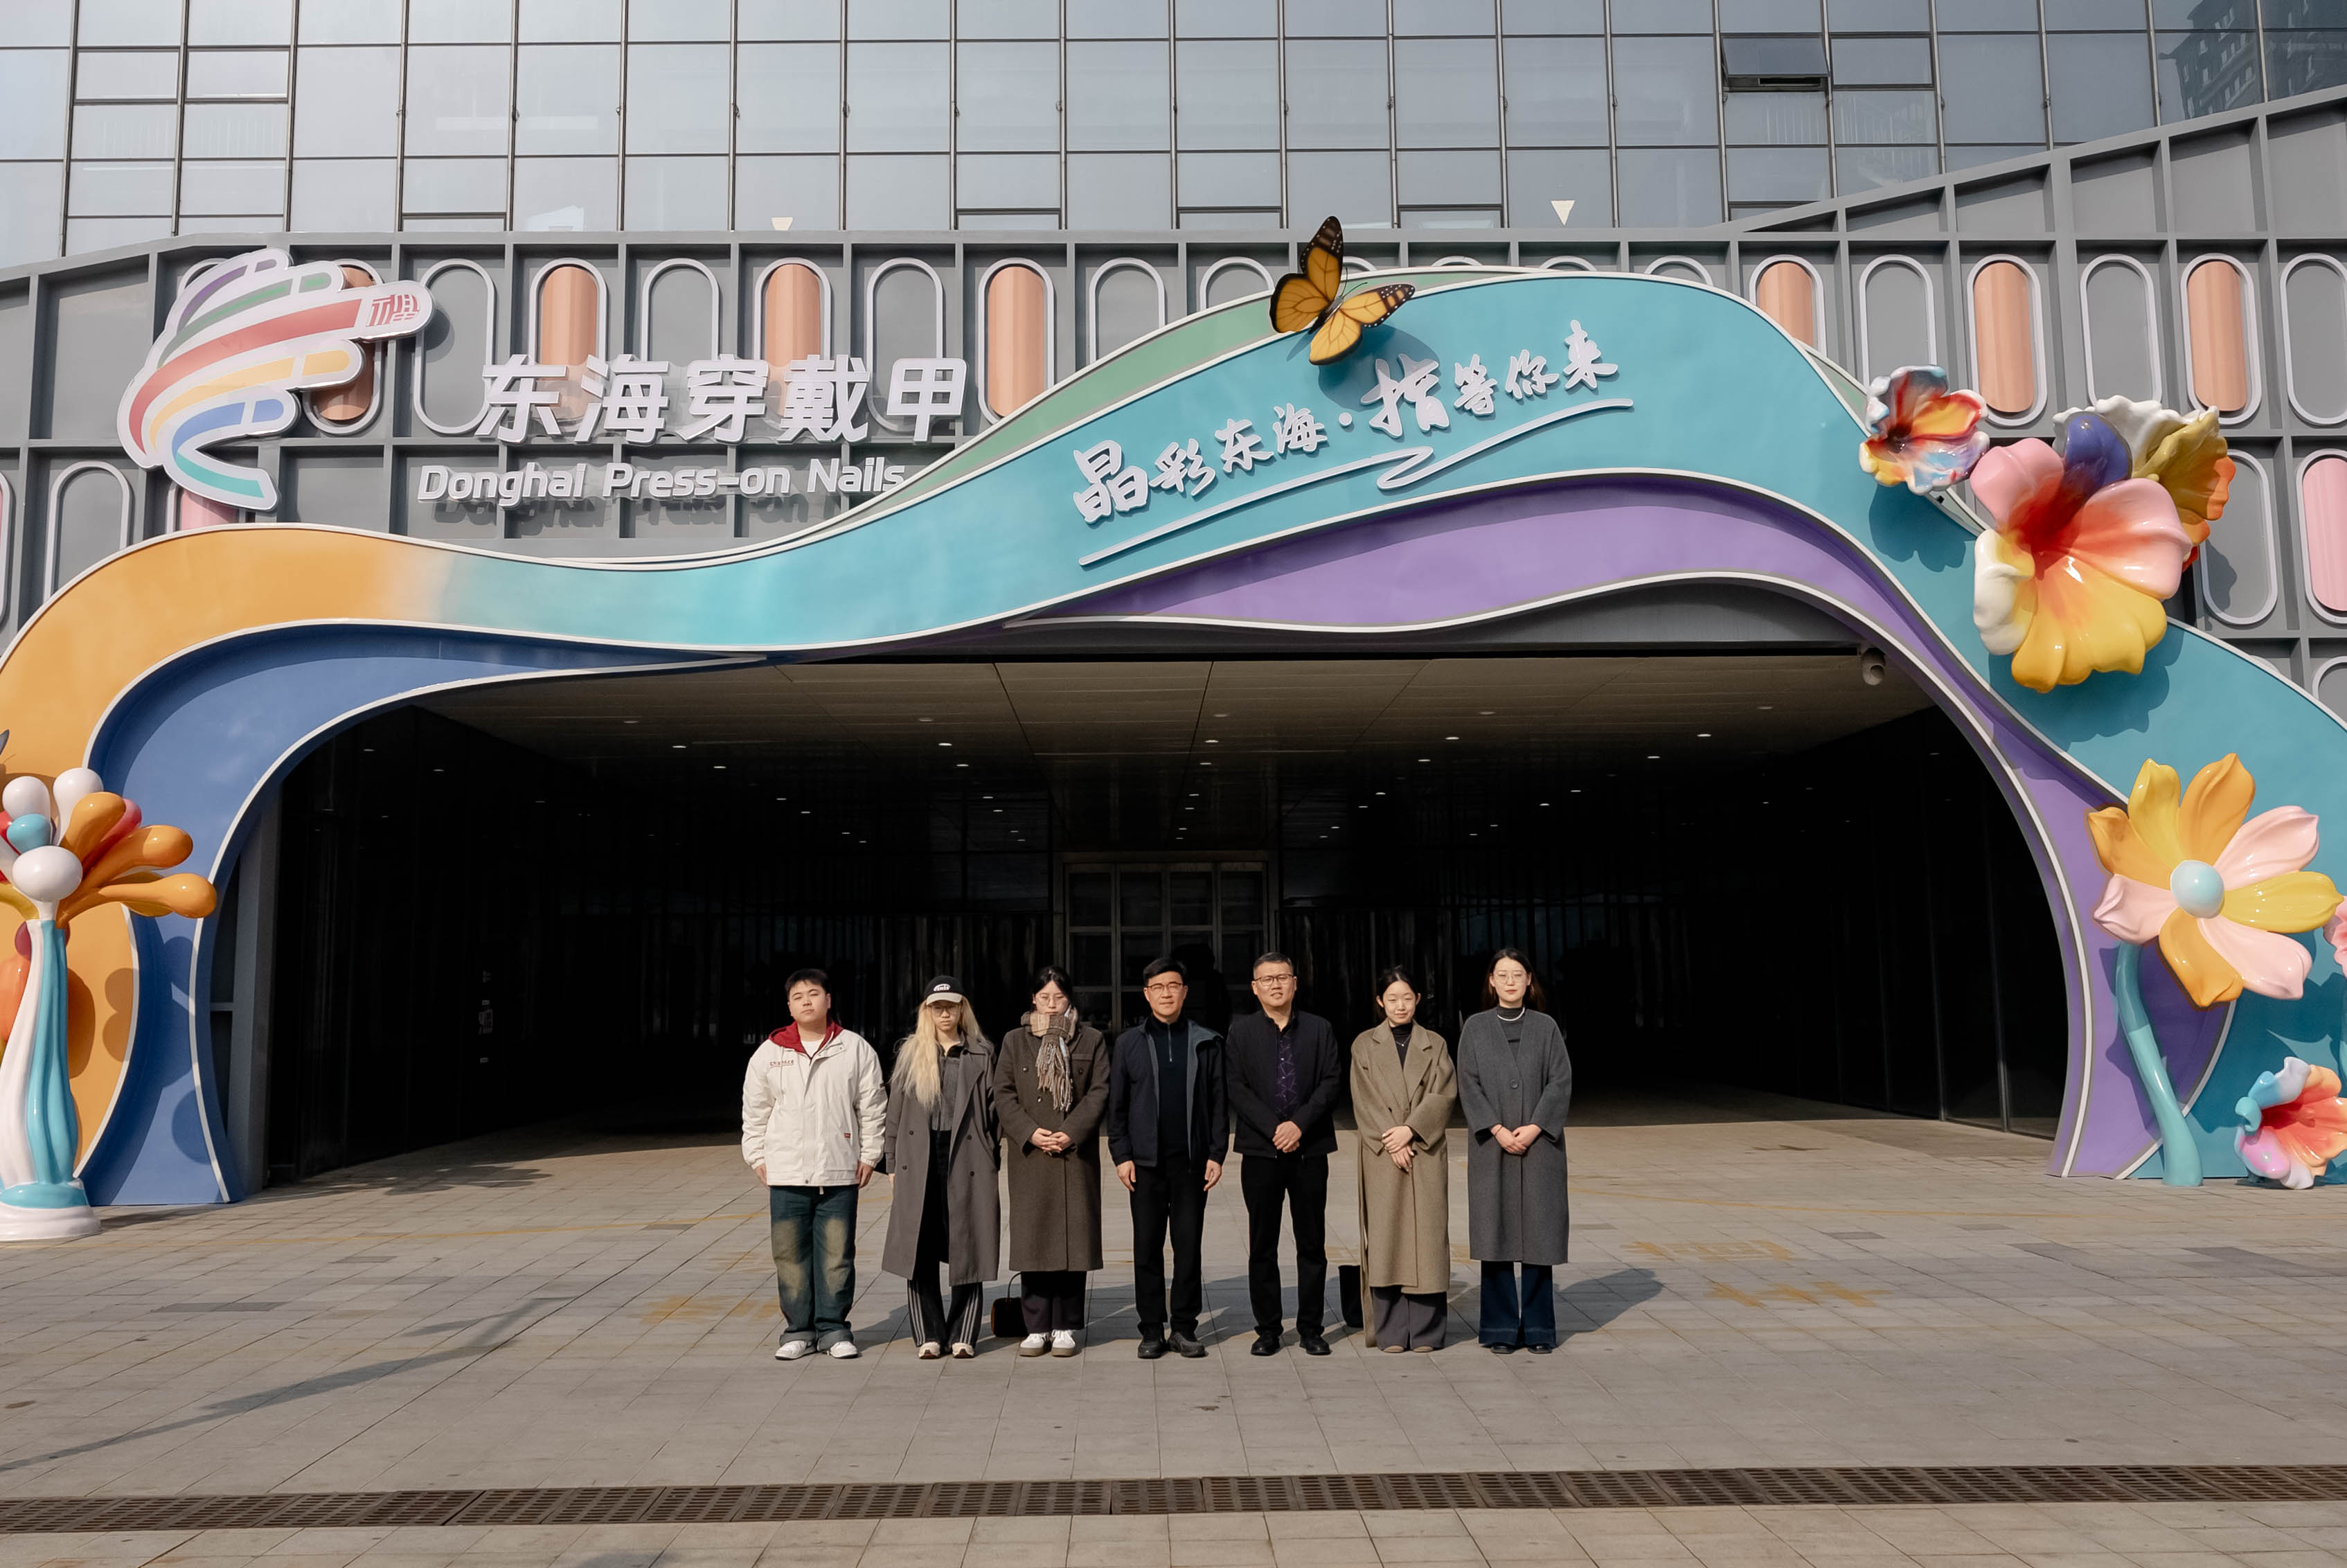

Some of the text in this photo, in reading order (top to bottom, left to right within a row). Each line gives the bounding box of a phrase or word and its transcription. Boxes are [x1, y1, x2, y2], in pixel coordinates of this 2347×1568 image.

[475, 353, 968, 445] 东海穿戴甲
[418, 456, 905, 508] Donghai Press-on Nails
